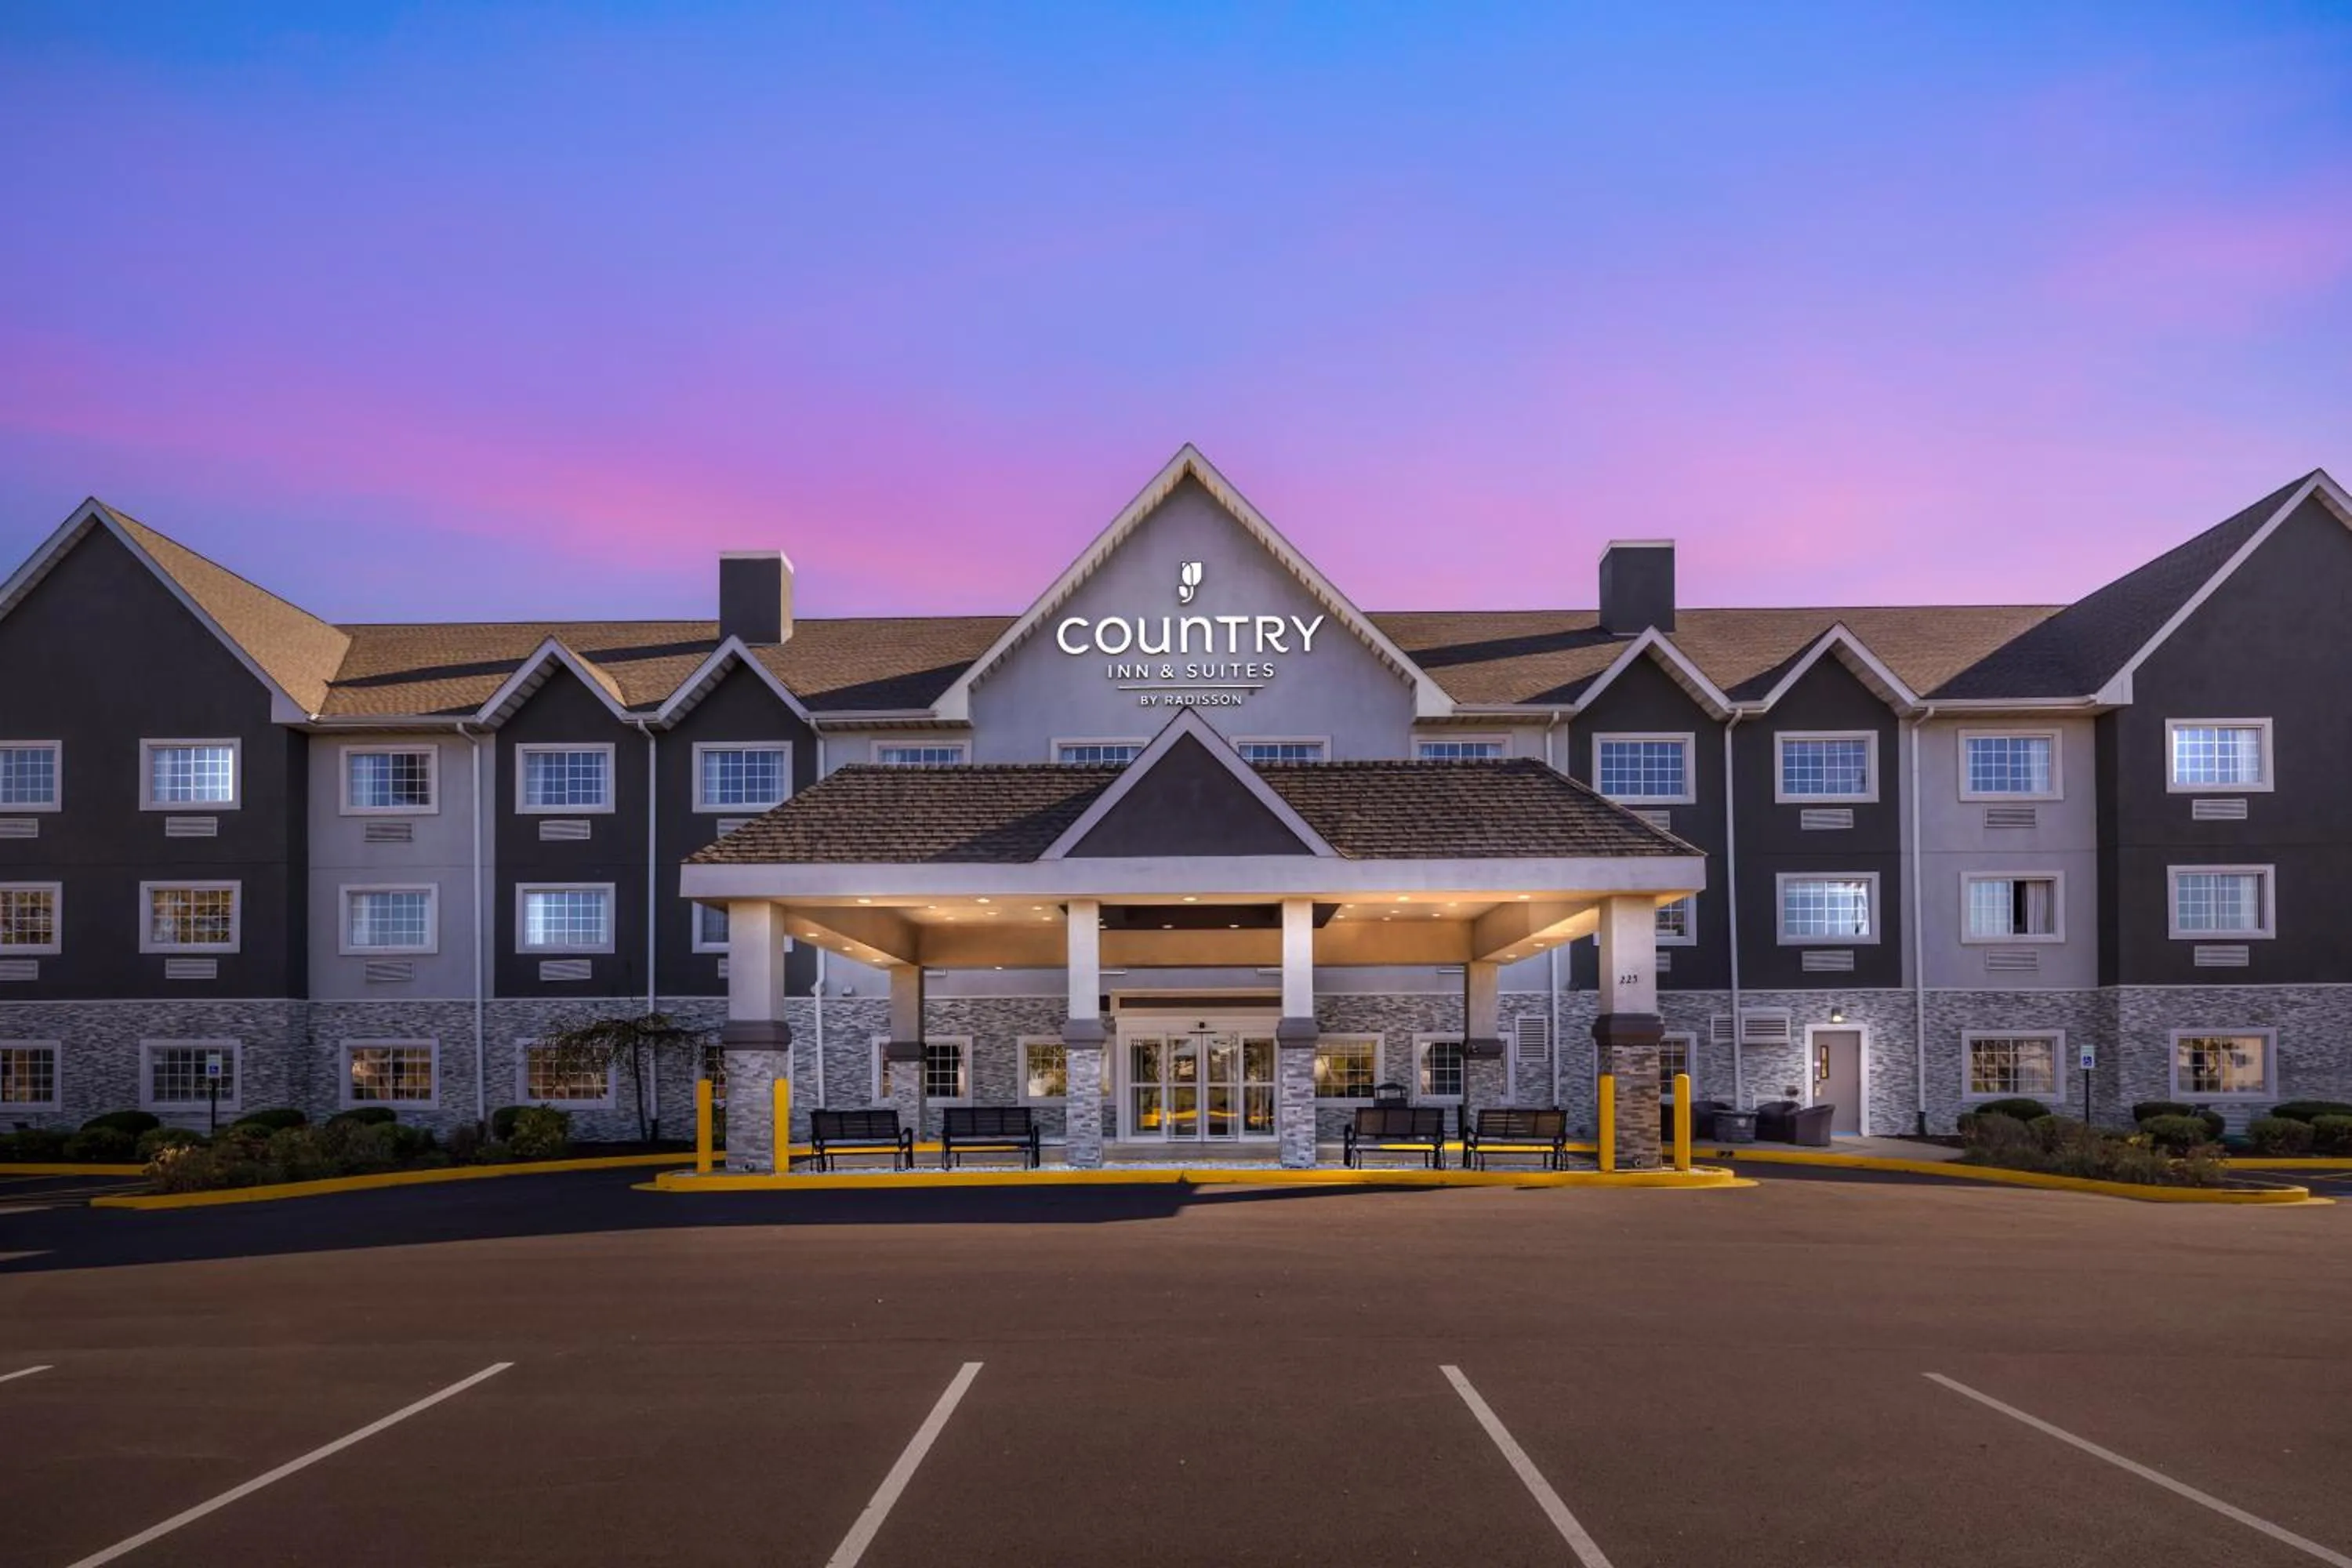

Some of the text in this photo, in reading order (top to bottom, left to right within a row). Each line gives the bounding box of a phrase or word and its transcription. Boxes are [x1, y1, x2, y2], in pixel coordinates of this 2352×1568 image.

[1057, 615, 1324, 654] COUNTRY
[1107, 662, 1274, 678] INN & SUITES
[1141, 694, 1242, 705] BY RADISSON
